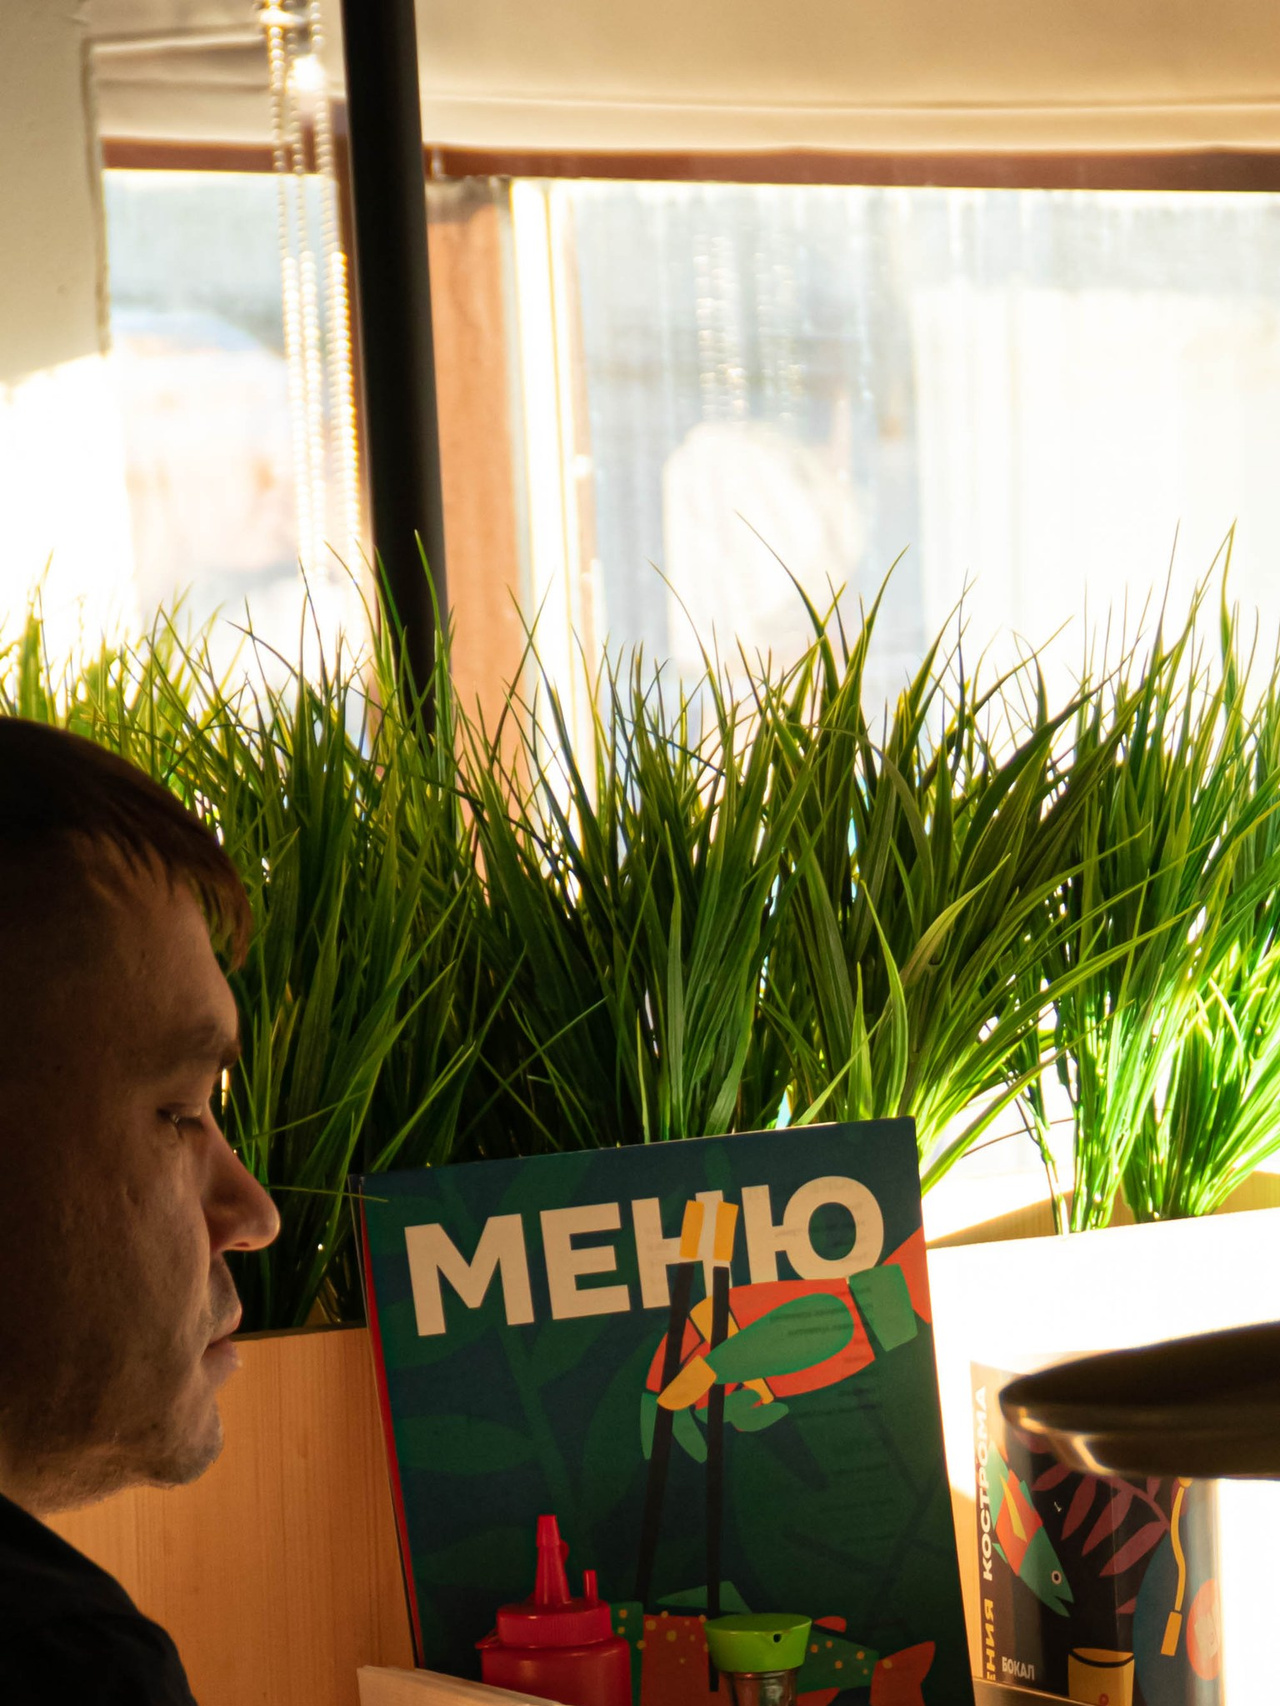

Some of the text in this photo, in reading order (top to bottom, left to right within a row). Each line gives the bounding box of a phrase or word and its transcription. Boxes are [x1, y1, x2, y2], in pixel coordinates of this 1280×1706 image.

[404, 1176, 884, 1337] МЕНЮ
[975, 1385, 993, 1582] КОСТРОМА
[1001, 1656, 1035, 1680] БОКАЛ
